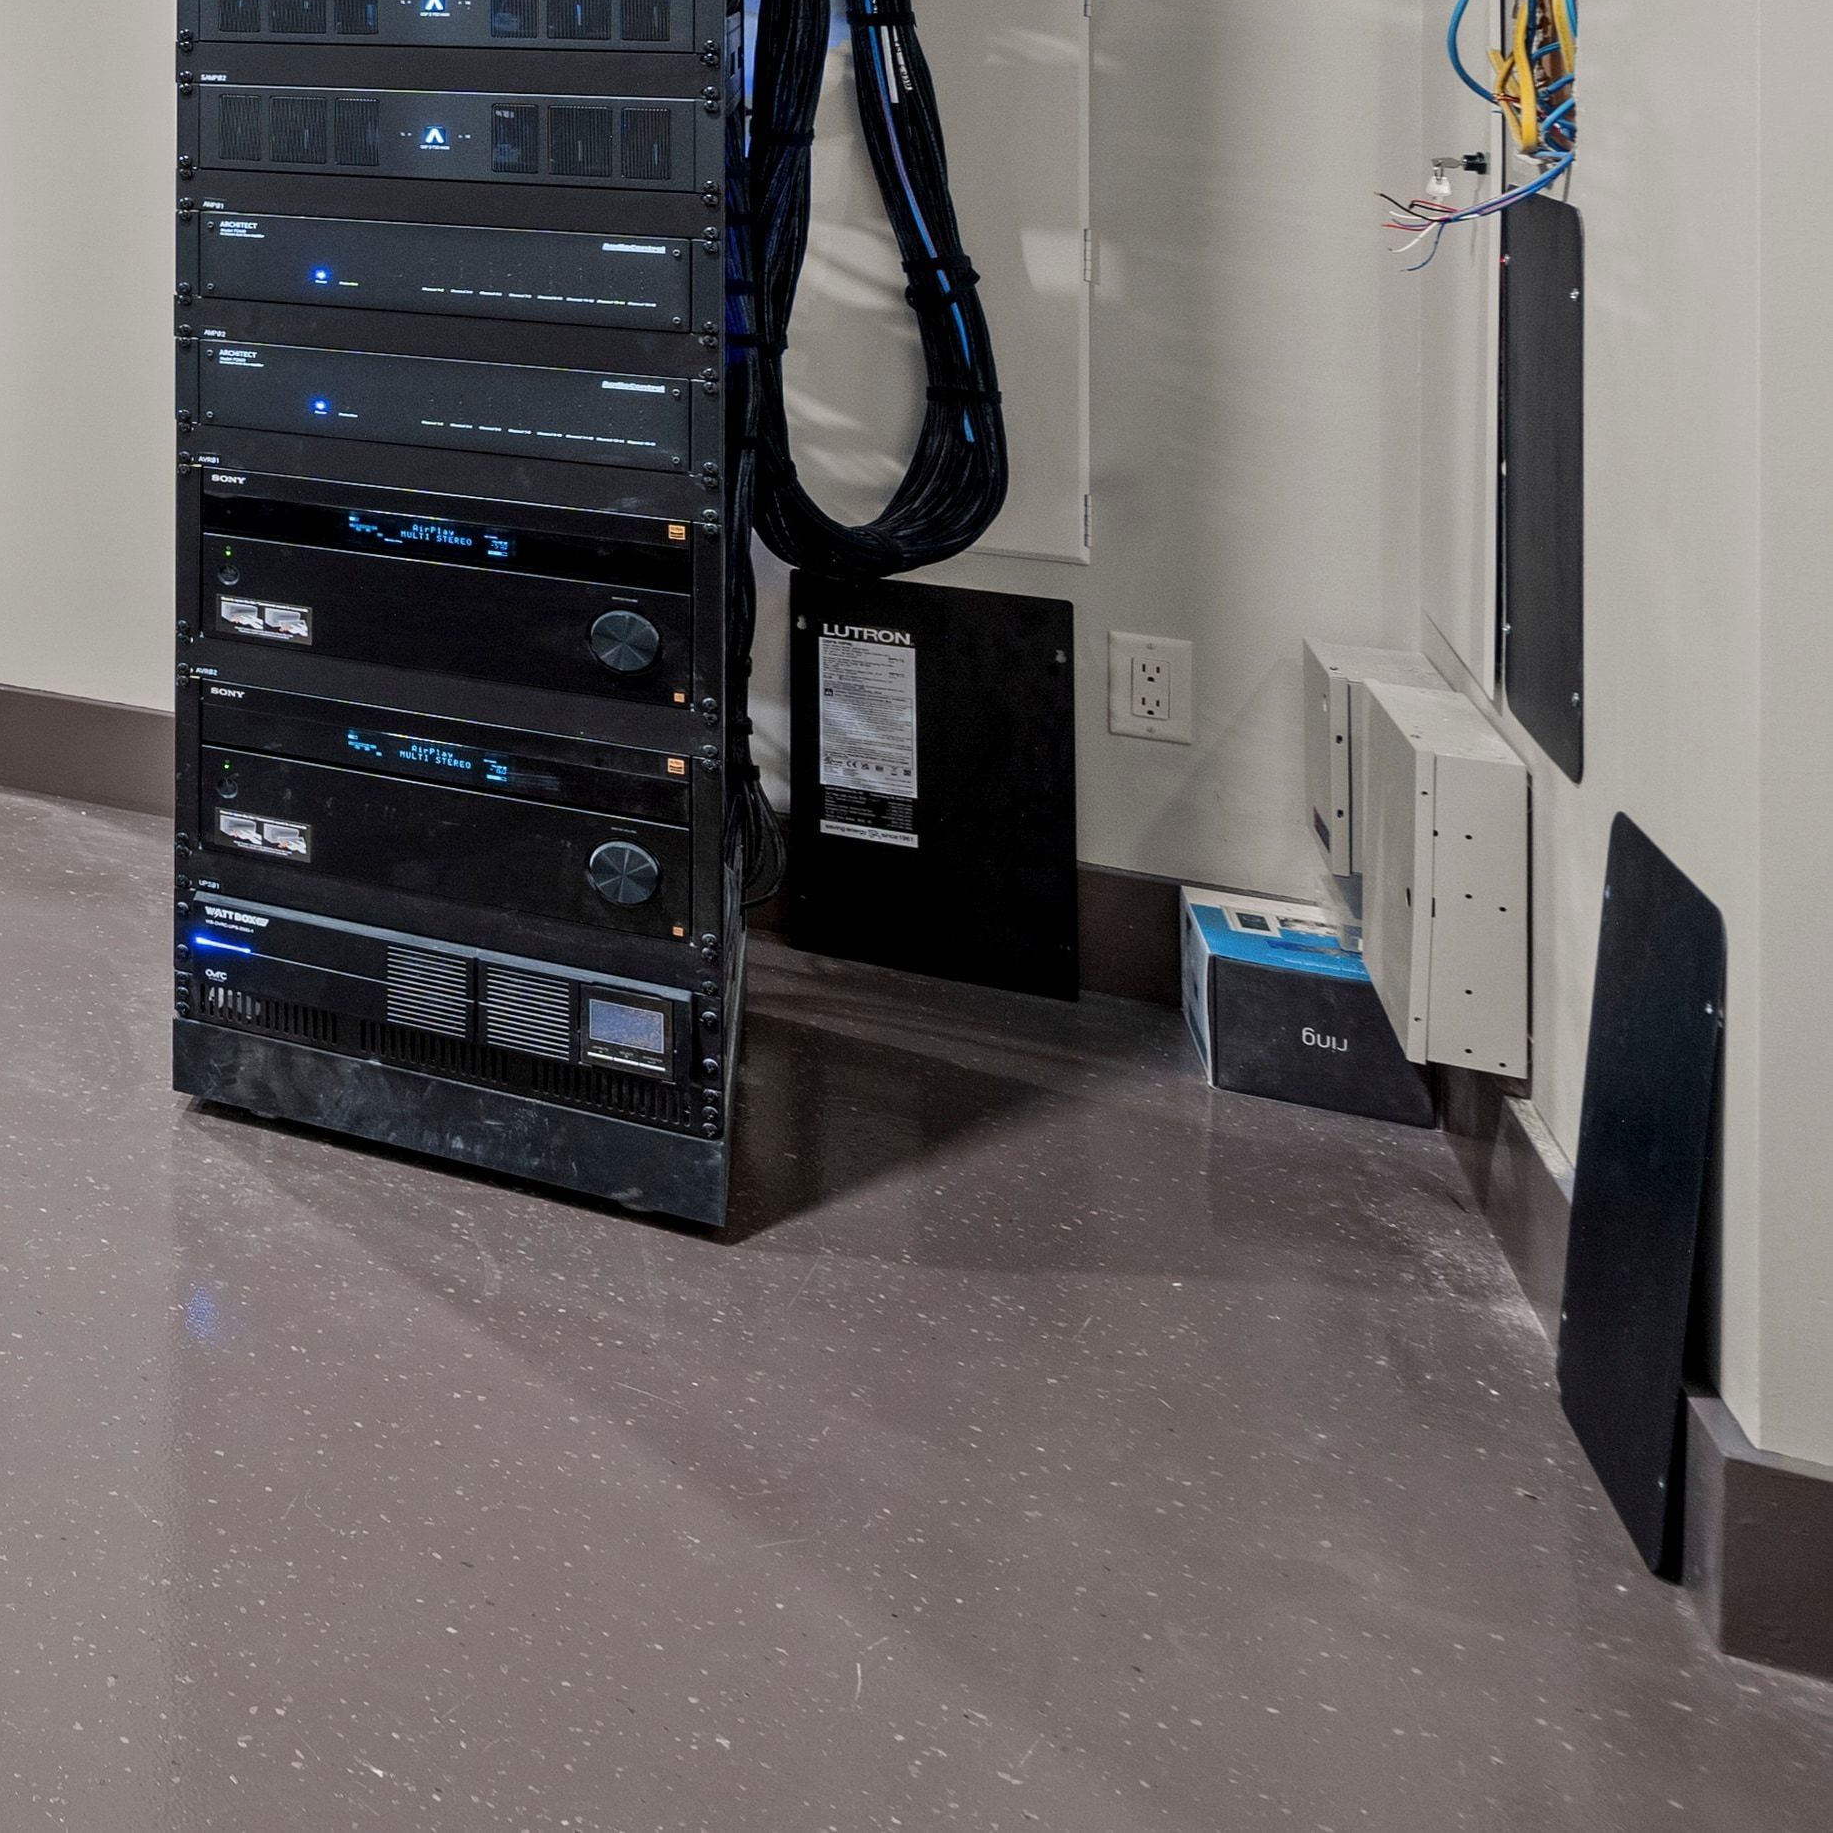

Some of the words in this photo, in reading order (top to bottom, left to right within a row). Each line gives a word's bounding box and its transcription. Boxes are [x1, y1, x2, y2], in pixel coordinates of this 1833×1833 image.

[211, 474, 247, 484] SONY
[412, 524, 455, 536] AirPlay
[436, 535, 473, 547] STEREO
[823, 623, 911, 645] LUTRON
[210, 686, 246, 698] SONY
[411, 744, 454, 758] AirPlay
[435, 756, 472, 769] STEREO
[205, 905, 256, 924] WATTBOX
[1301, 1026, 1349, 1053] ring
